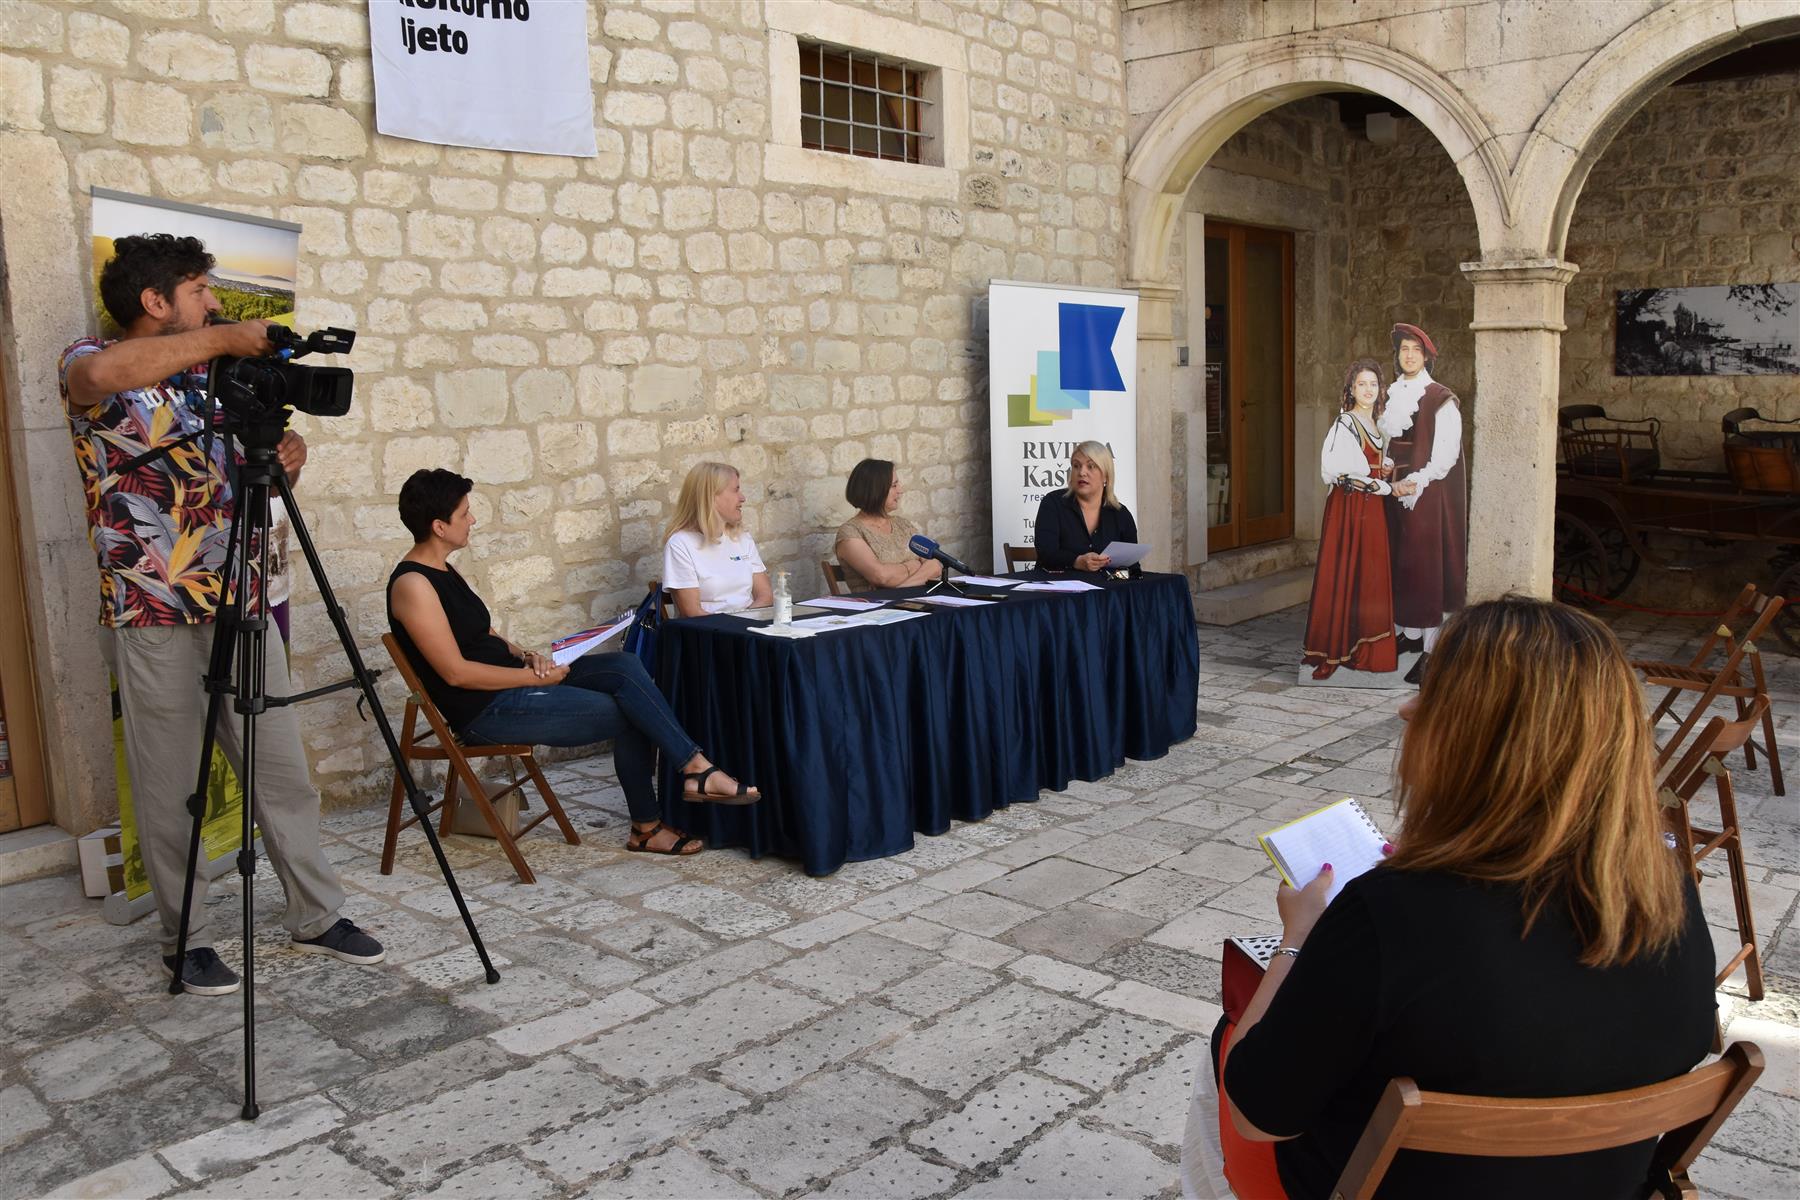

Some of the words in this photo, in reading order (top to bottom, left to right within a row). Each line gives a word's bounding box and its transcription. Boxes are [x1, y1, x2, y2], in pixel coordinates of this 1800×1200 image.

[400, 16, 469, 55] ljeto
[1023, 494, 1028, 504] 7
[1030, 494, 1046, 502] rea
[1023, 518, 1036, 529] Tu
[1023, 535, 1035, 544] za
